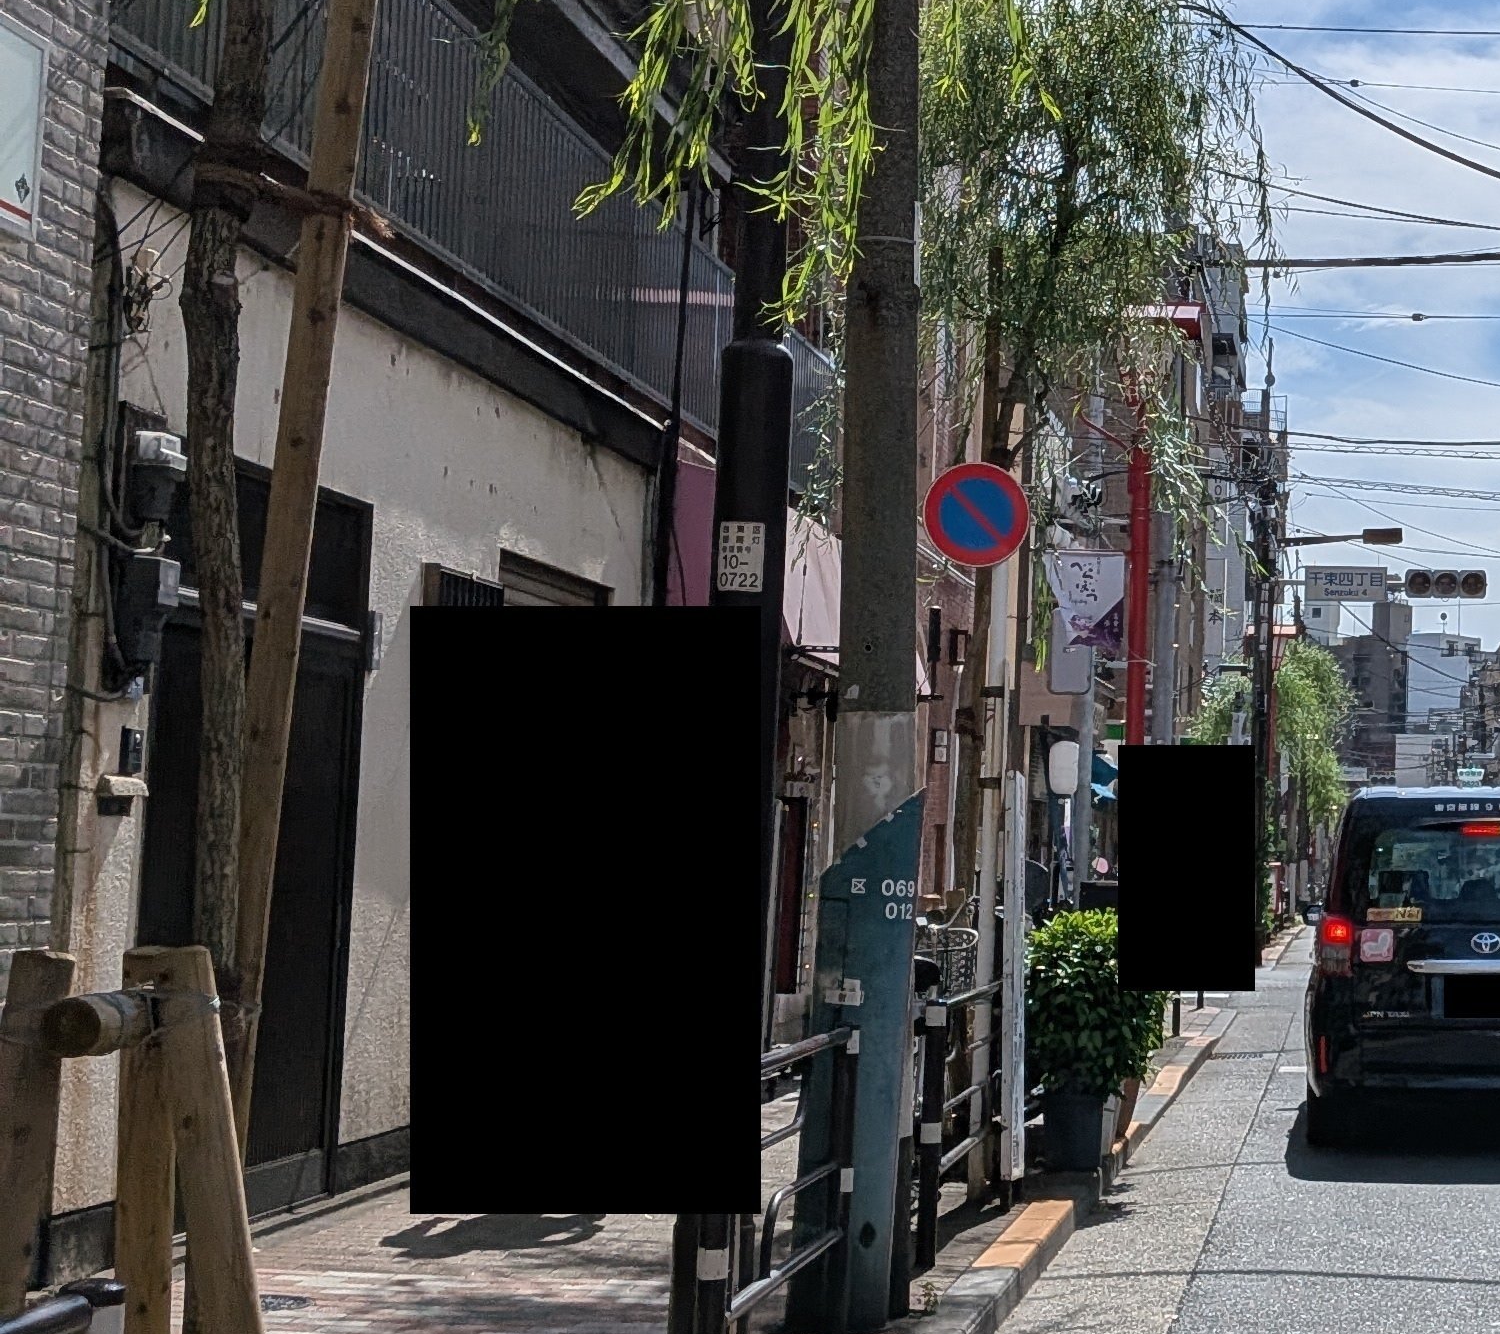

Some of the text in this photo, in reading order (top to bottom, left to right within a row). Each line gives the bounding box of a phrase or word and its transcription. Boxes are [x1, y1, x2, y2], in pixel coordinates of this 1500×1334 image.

[722, 554, 749, 570] 10-
[719, 572, 759, 588] 0722
[1308, 571, 1384, 587] 千束四丁目
[851, 878, 915, 898] 区 069
[885, 902, 913, 920] 012
